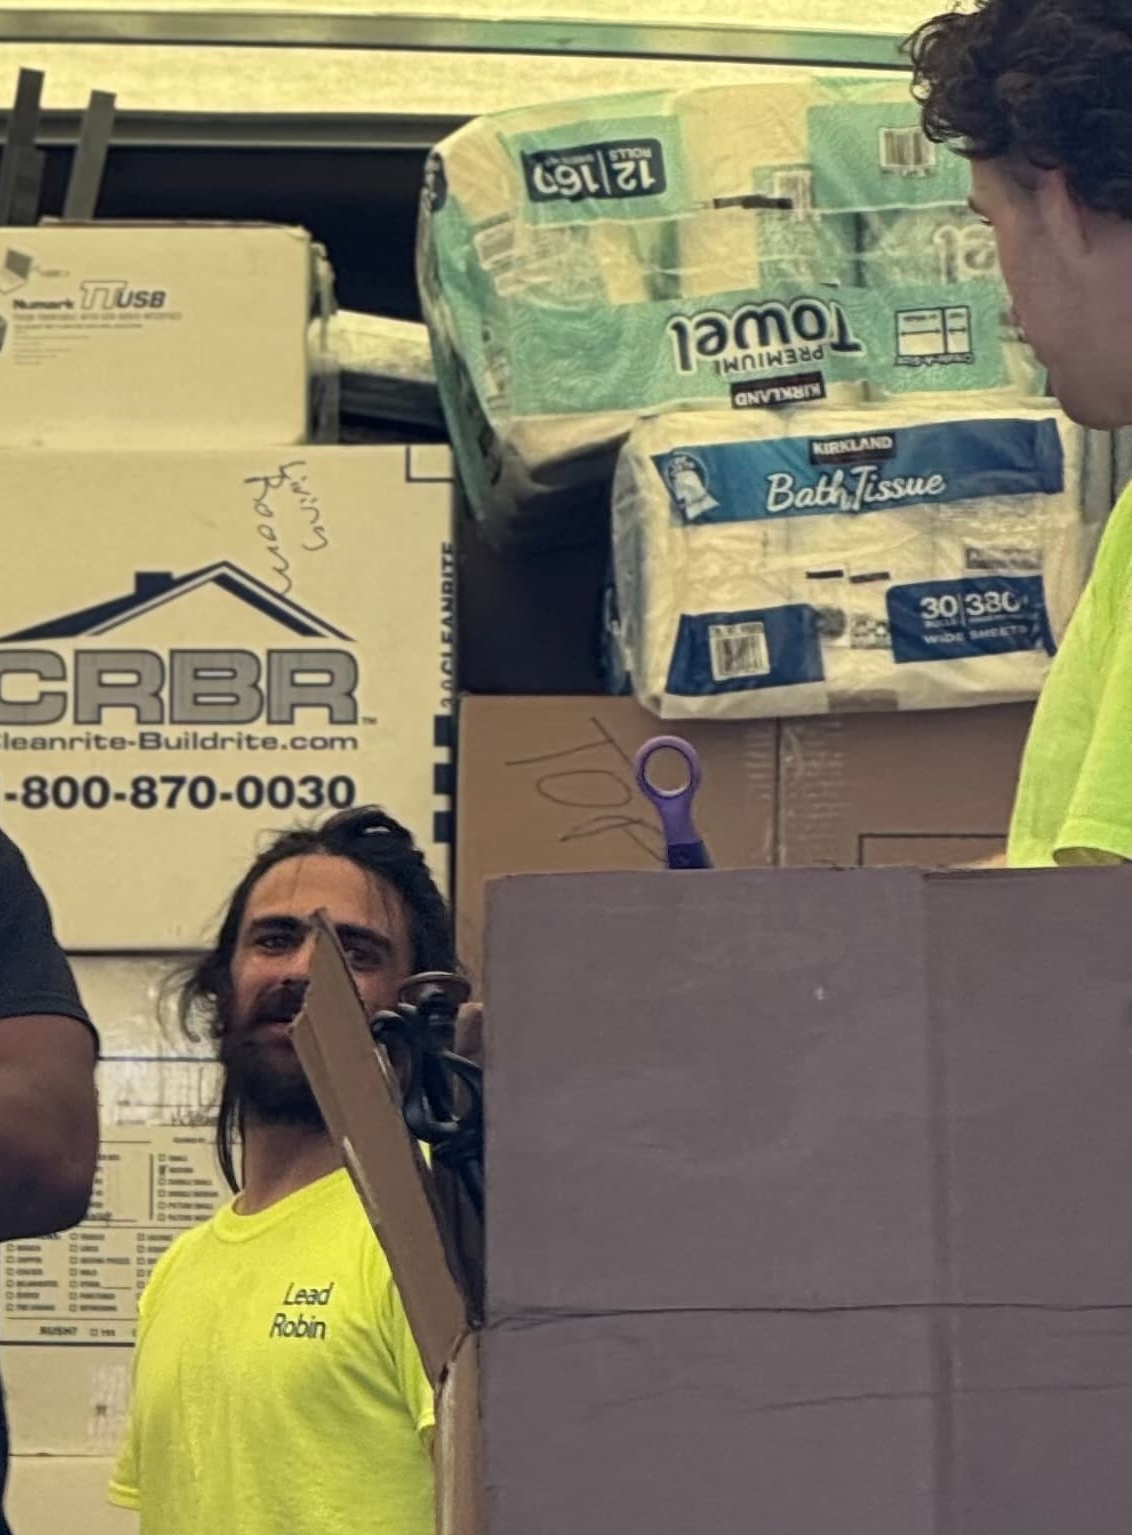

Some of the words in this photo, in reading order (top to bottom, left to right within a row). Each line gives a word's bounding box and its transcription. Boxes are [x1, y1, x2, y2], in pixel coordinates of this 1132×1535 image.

[612, 160, 656, 191] 12
[670, 298, 863, 374] Towel
[723, 346, 825, 374] PREMIUM
[734, 382, 823, 407] KIRKLAND
[812, 436, 894, 456] KIRKLAND
[767, 472, 853, 513] Bath
[846, 465, 947, 512] Tissue
[920, 596, 959, 620] 30
[283, 1282, 335, 1305] Lead
[269, 1313, 326, 1340] Robin
